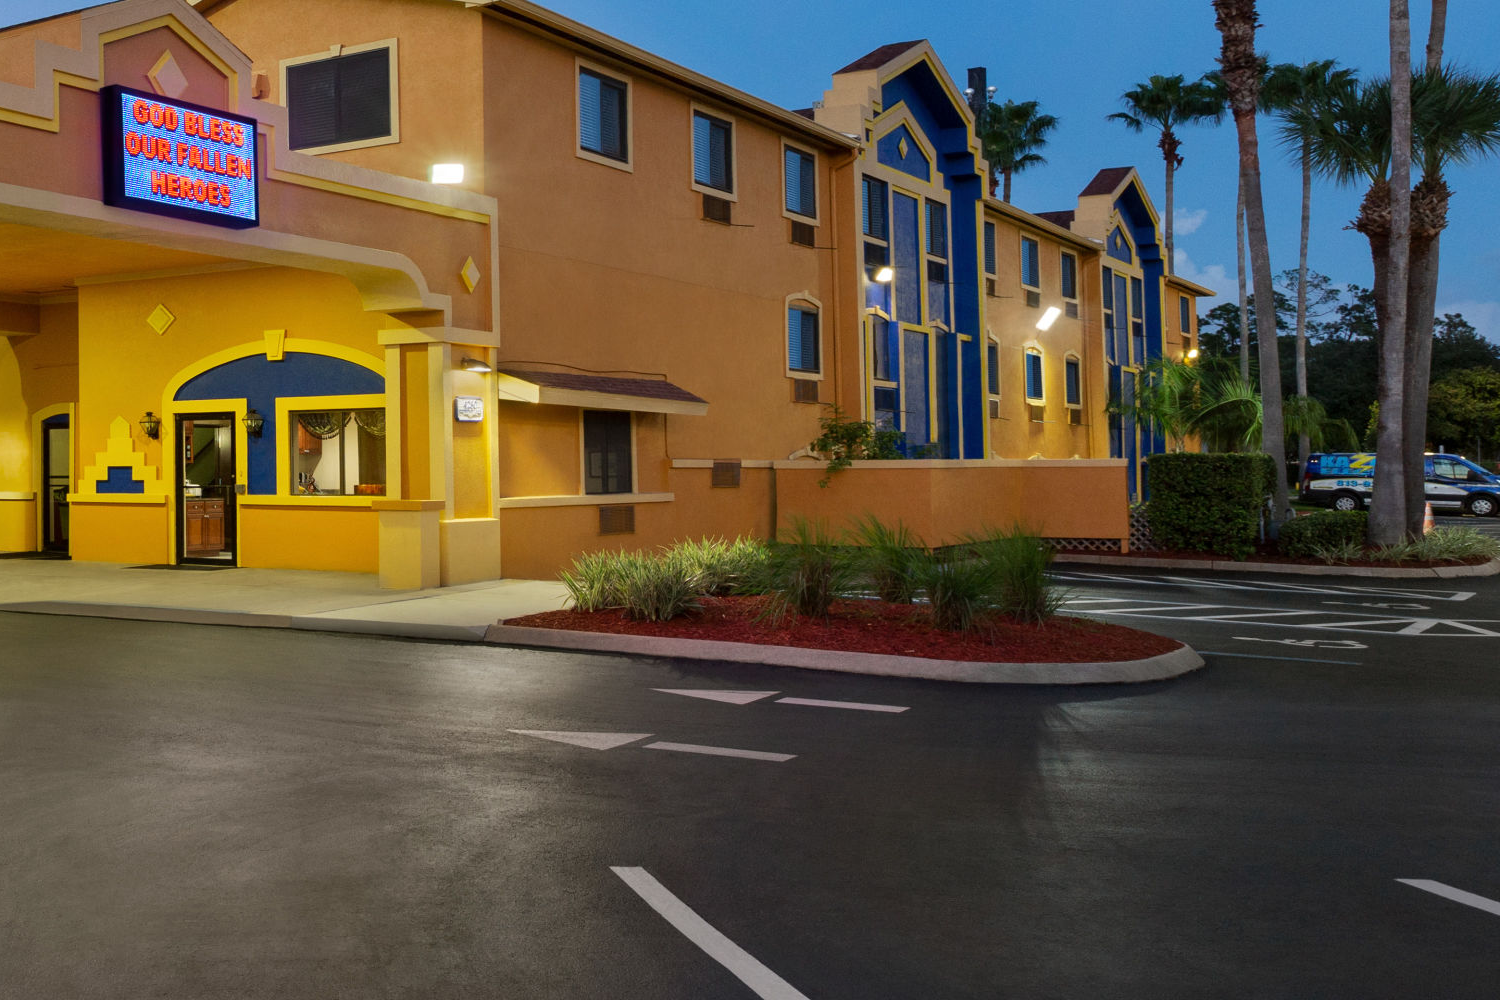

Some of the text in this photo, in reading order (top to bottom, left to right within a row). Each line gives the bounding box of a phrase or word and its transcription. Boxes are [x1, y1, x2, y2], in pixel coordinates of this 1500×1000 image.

[132, 99, 245, 148] GOD BLESS
[125, 131, 252, 180] OUR FALLEN
[151, 169, 232, 208] HEROES
